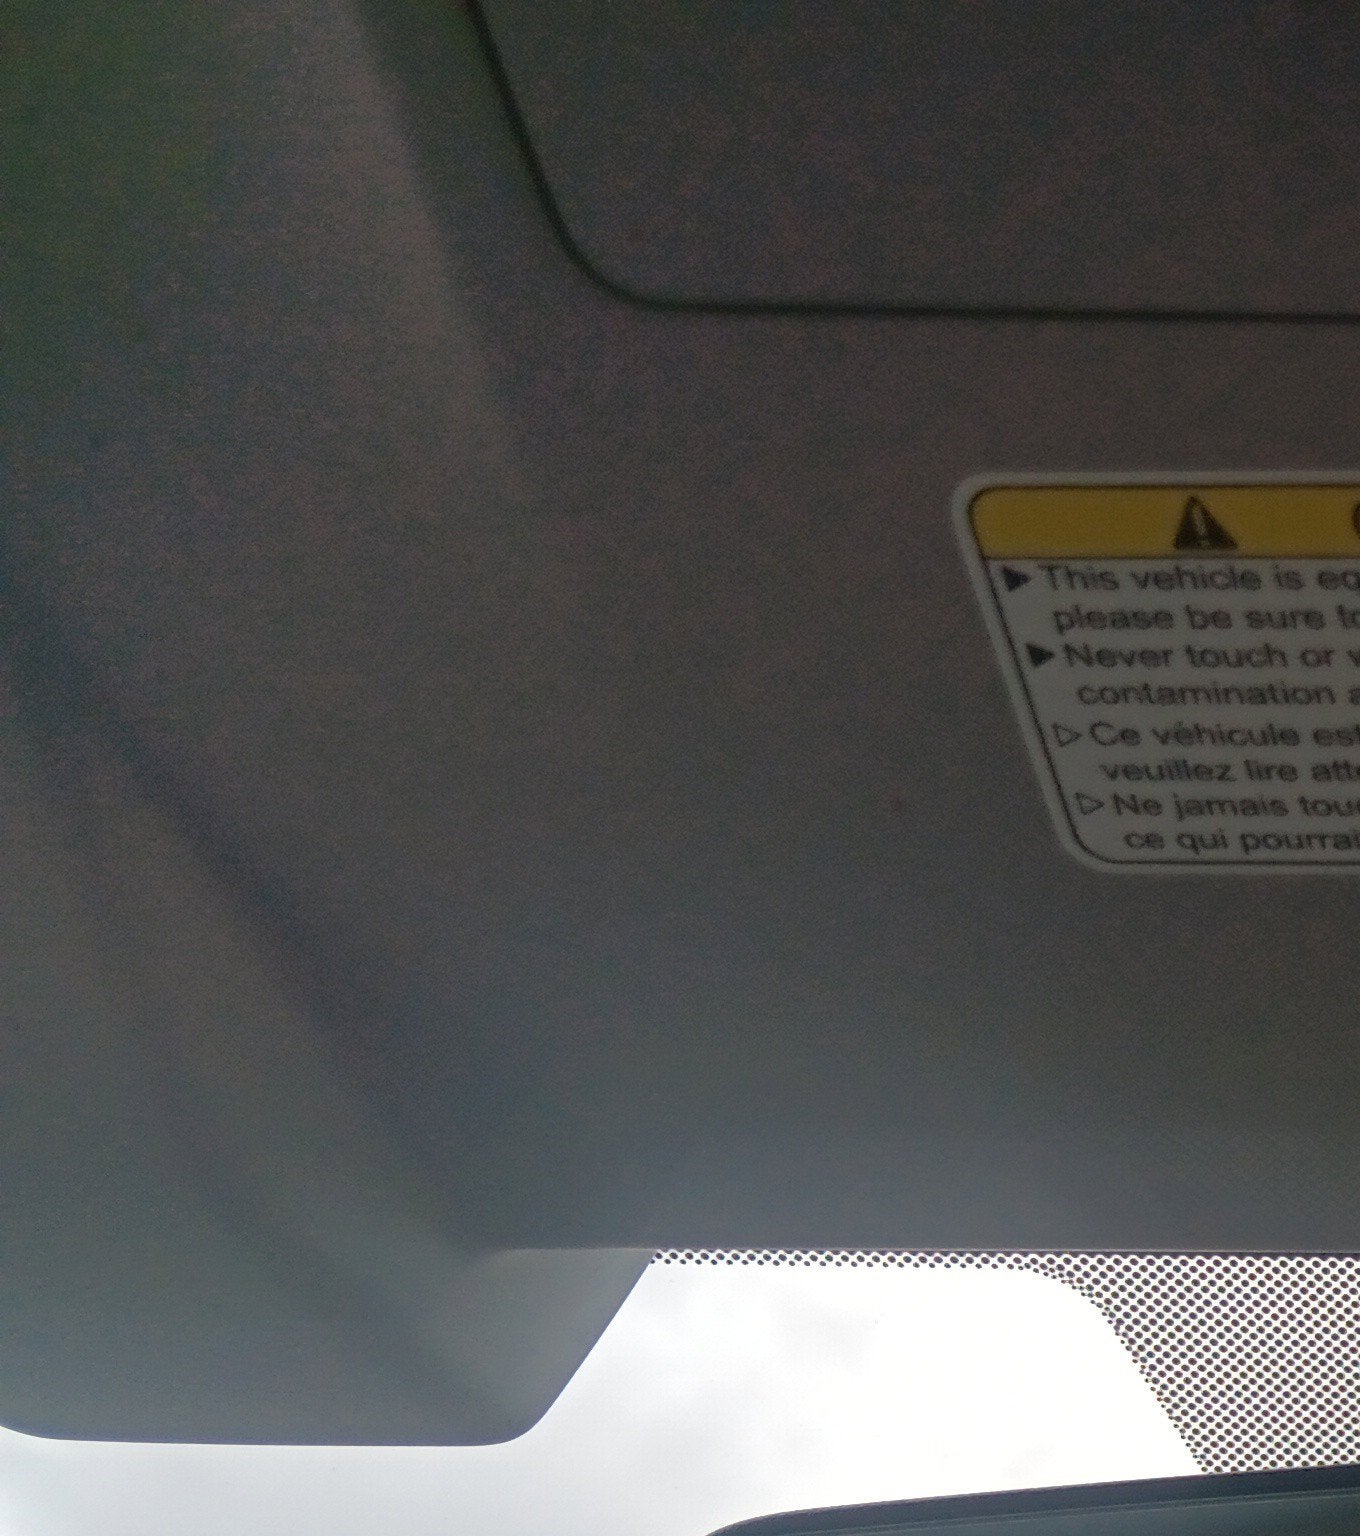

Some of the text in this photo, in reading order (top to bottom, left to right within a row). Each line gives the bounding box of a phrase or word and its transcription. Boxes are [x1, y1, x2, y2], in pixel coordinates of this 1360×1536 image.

[1040, 566, 1118, 591] This
[1132, 565, 1262, 590] vehicle
[1276, 566, 1304, 589] is
[1053, 604, 1173, 633] please
[1188, 604, 1232, 630] be
[1247, 609, 1324, 630] sure
[1064, 643, 1173, 667] Never
[1187, 642, 1287, 667] touch
[1301, 648, 1333, 667] or
[1077, 682, 1335, 706] contamination
[1090, 721, 1141, 746] Ce
[1153, 720, 1300, 746] véhicule
[1101, 759, 1236, 782] veuillez
[1248, 759, 1299, 782] lire
[1112, 794, 1162, 817] Ne
[1174, 794, 1289, 822] jamais
[1124, 830, 1164, 850] ce
[1176, 829, 1226, 855] qui
